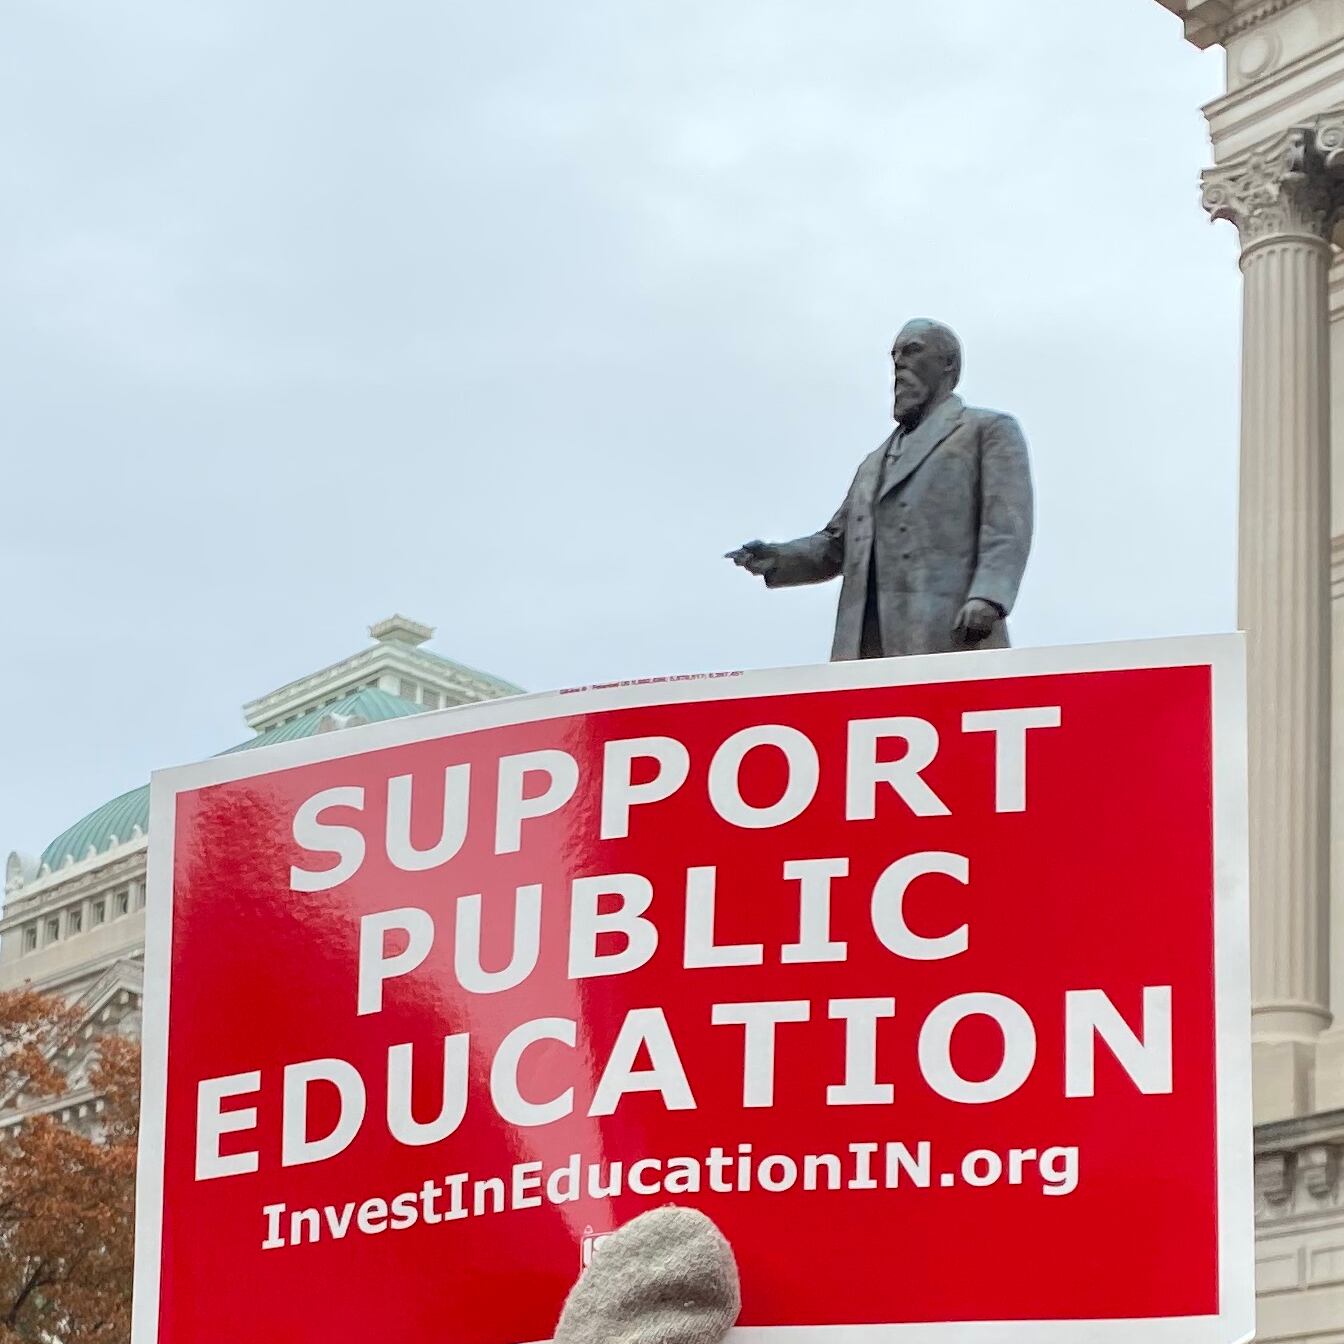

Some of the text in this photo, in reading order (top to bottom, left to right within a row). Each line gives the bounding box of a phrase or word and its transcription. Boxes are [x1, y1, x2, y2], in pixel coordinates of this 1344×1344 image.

[289, 706, 1062, 894] SUPPORT
[355, 851, 971, 1016] PUBLIC
[194, 985, 1175, 1182] EDUCATION
[261, 1140, 1080, 1250] InvestInEducationIN.org
